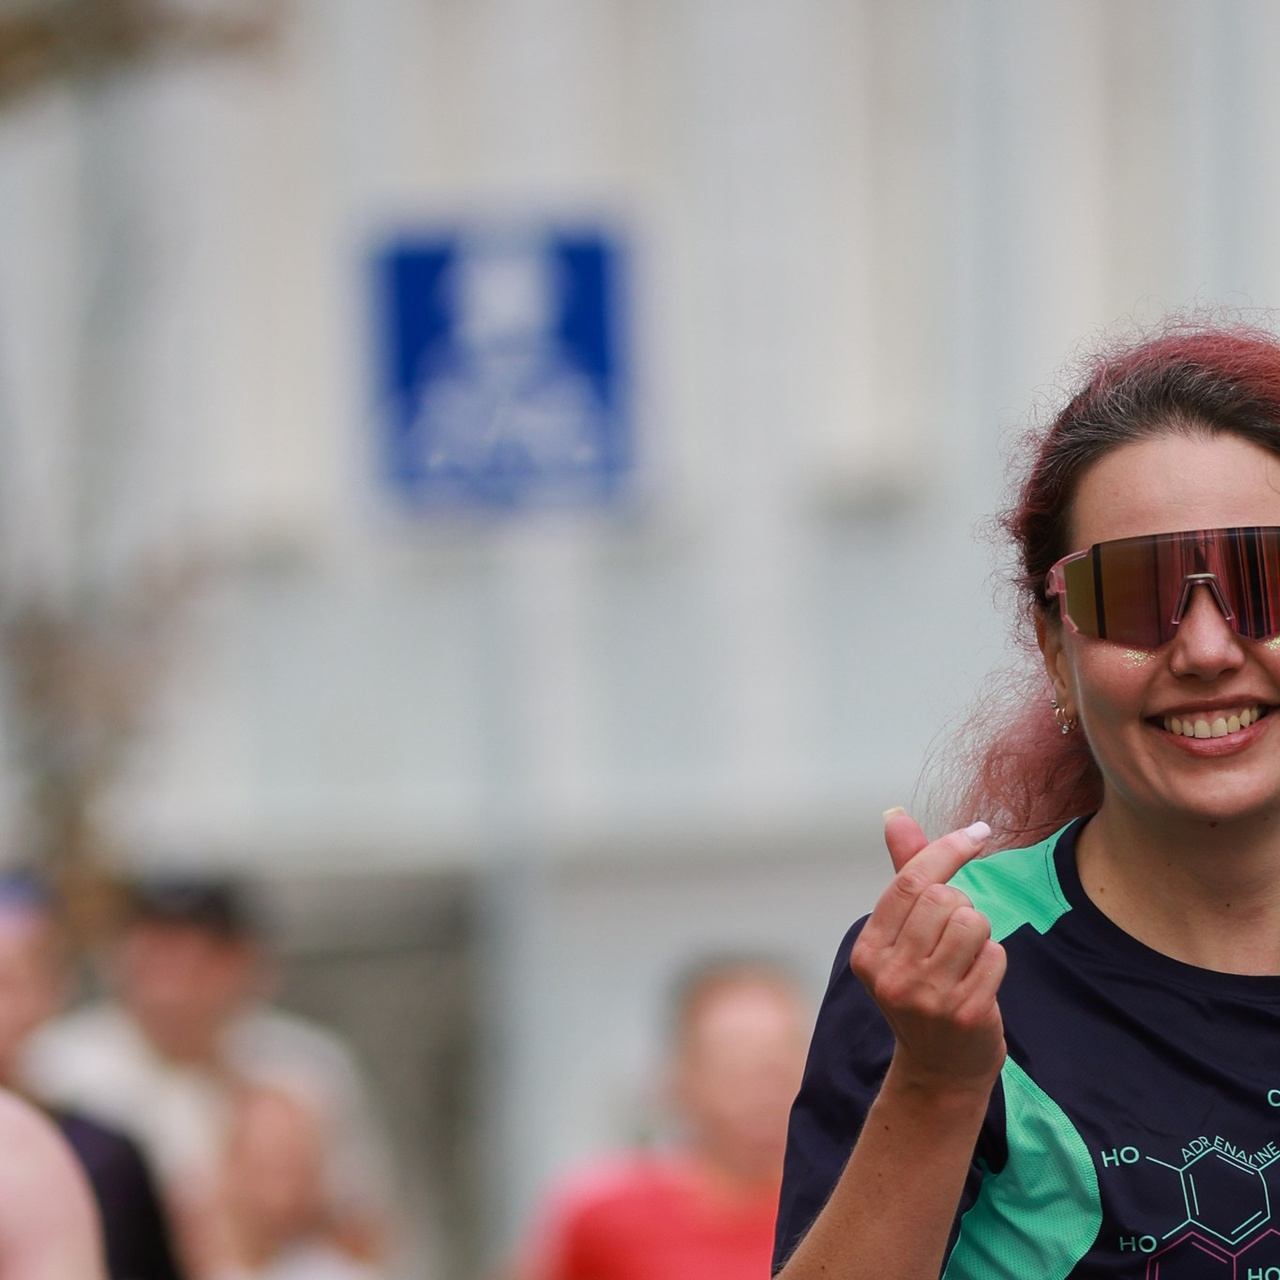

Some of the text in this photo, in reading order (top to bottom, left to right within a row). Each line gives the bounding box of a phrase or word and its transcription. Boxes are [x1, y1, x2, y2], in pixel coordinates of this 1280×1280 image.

[1101, 1146, 1140, 1168] HO
[1180, 1135, 1280, 1168] ADRENALINE
[1119, 1235, 1158, 1253] HO
